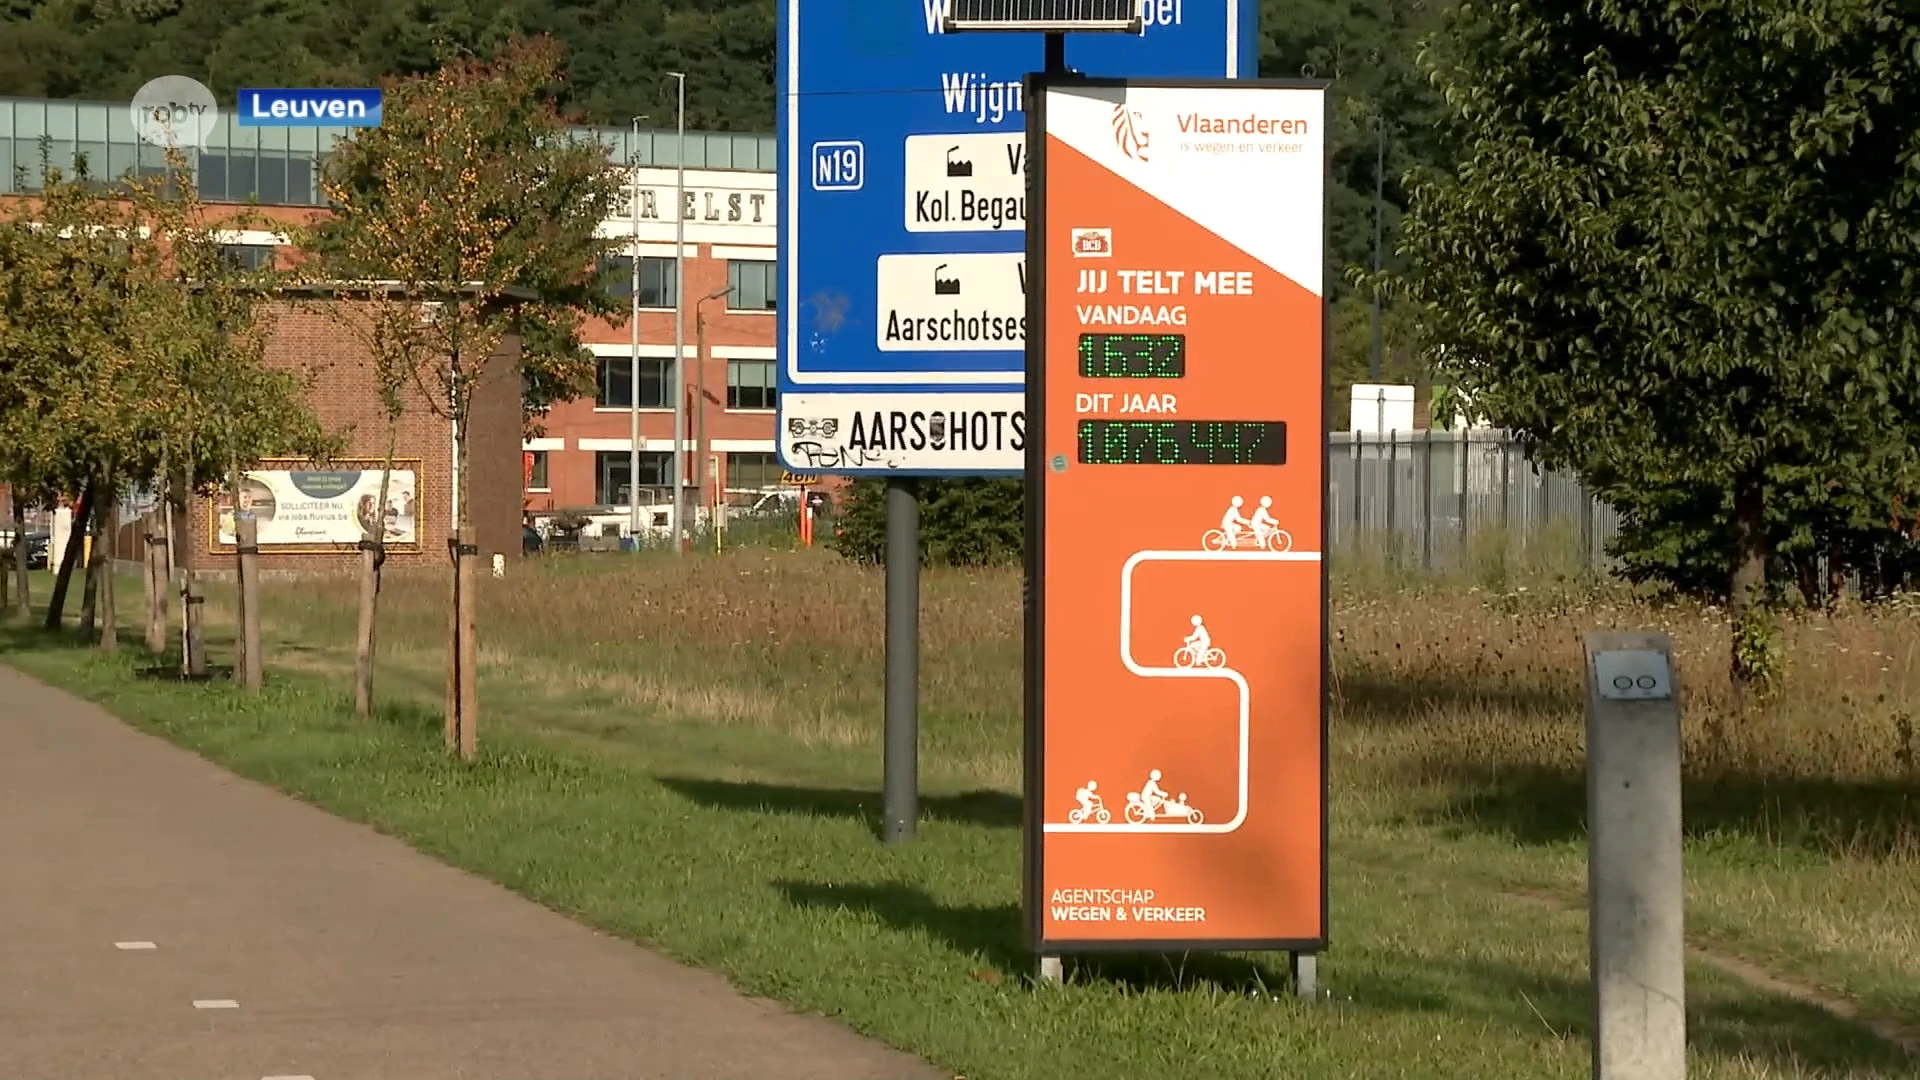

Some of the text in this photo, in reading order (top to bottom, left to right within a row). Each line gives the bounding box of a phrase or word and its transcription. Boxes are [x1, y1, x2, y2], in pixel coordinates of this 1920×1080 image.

[1176, 112, 1308, 134] Vlaanderen
[1194, 143, 1234, 155] wegen
[1239, 144, 1254, 152] en
[1258, 143, 1304, 153] verkeer
[819, 149, 857, 183] N19
[681, 191, 765, 222] ELST
[1076, 269, 1254, 295] JIJ TELT MEE
[1076, 305, 1188, 326] VANDAAG
[1076, 393, 1178, 414] DIT JAAR
[1078, 422, 1266, 464] 1.076.447
[1051, 889, 1155, 904] AGENTSCHAP
[1051, 906, 1206, 922] WEGEN & VERKEER
